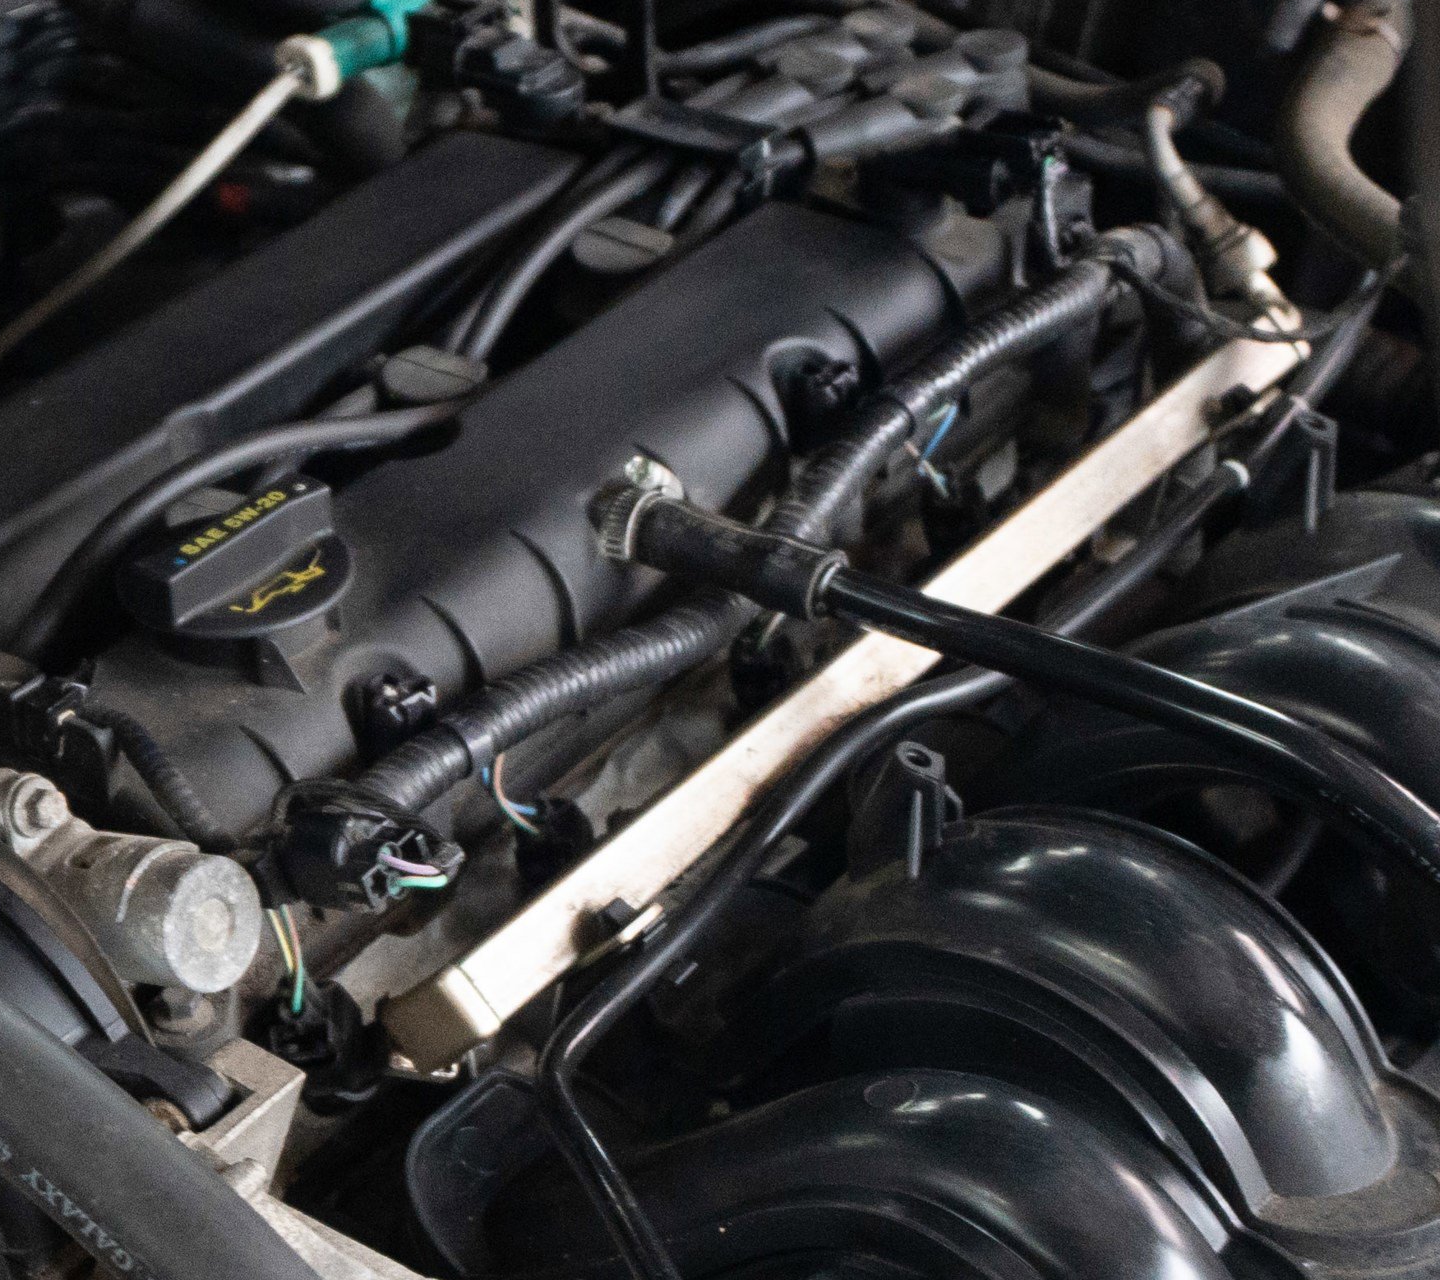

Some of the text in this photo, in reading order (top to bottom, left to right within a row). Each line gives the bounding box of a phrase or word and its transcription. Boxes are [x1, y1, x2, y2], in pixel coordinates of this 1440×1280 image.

[179, 491, 287, 555] SAE 5W-20
[21, 1167, 133, 1272] GALAXY
